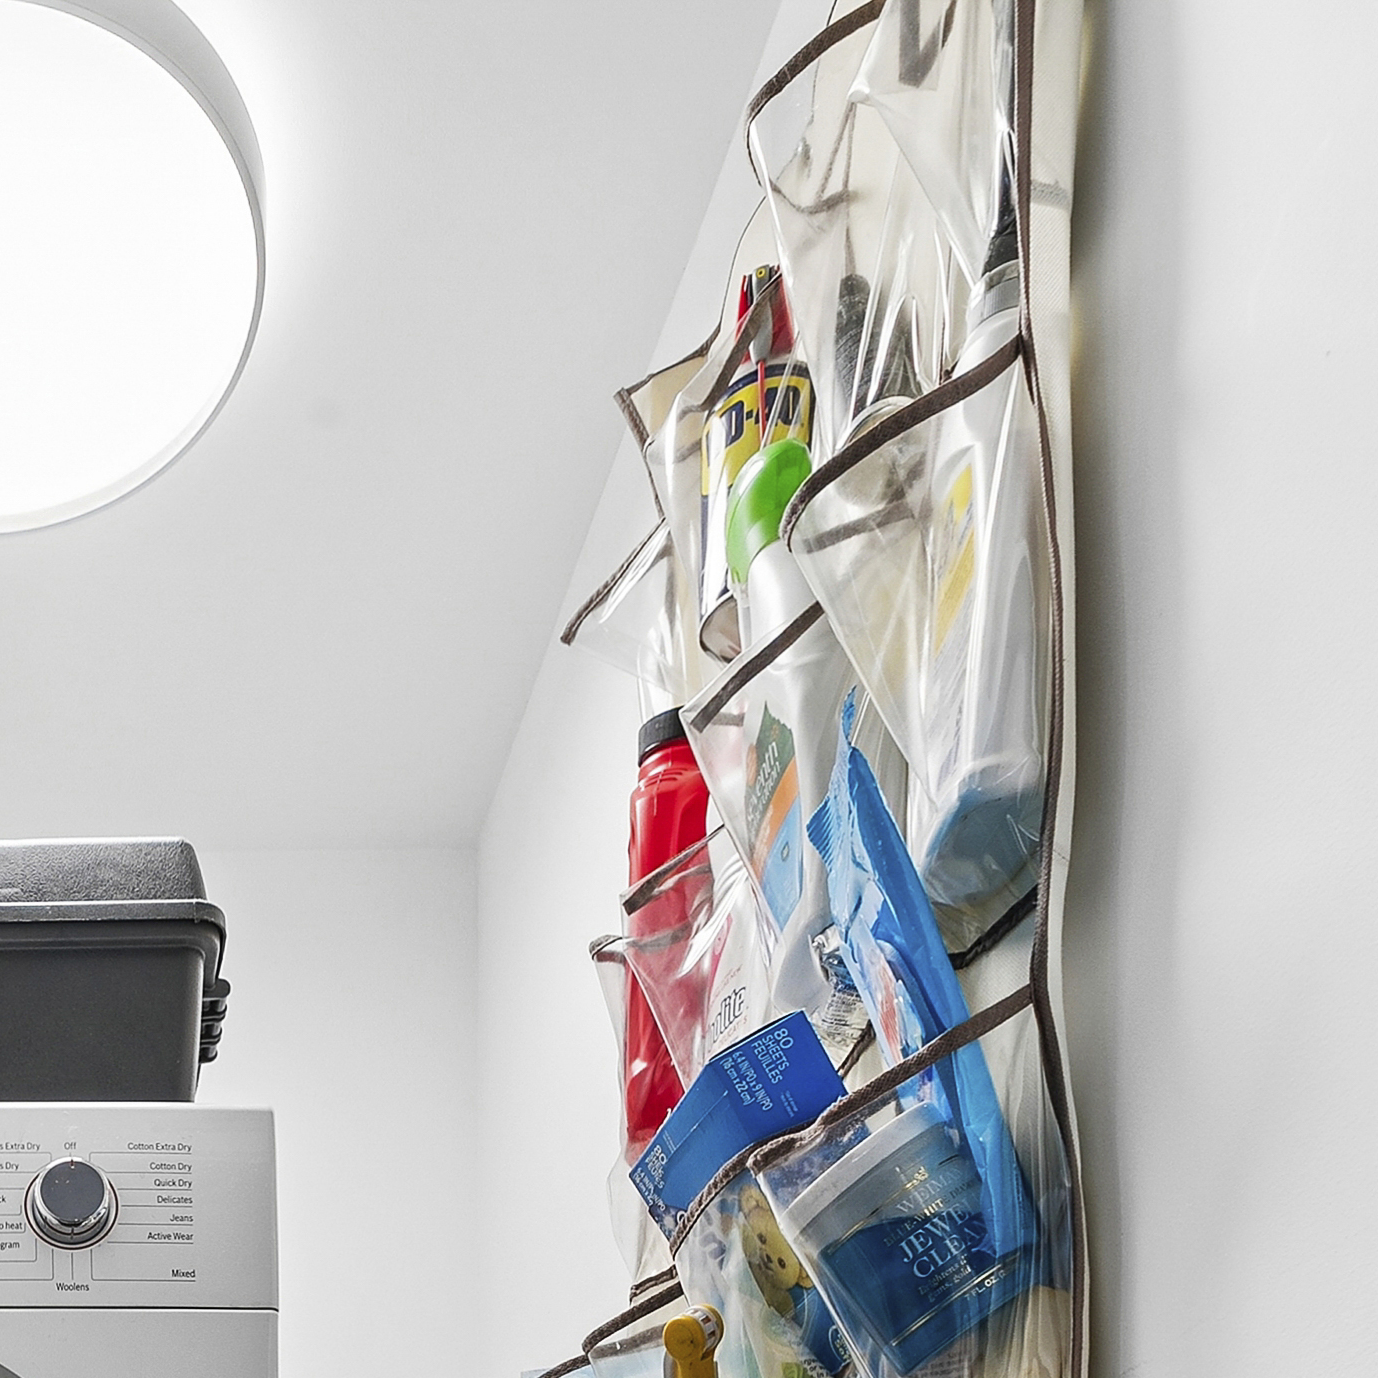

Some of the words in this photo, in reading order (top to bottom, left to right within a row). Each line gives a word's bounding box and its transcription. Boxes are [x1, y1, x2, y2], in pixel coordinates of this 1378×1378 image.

[774, 1028, 794, 1049] 80
[762, 1034, 790, 1070] SHEETS
[751, 1041, 783, 1084] FEUILLES
[735, 1081, 749, 1093] 22
[5, 1142, 25, 1150] Extra
[26, 1142, 41, 1151] Dry
[64, 1142, 77, 1150] Off
[127, 1142, 154, 1151] Cotton
[156, 1143, 176, 1151] Extra
[177, 1143, 192, 1152] Dry
[654, 1144, 667, 1164] 80
[5, 1161, 19, 1171] Dry
[149, 1162, 177, 1170] Cotton
[178, 1162, 192, 1172] Dry
[154, 1178, 177, 1187] Quick
[178, 1179, 192, 1188] Dry
[157, 1195, 193, 1204] Delicates
[170, 1214, 194, 1223] Jeans
[5, 1221, 23, 1230] heat
[147, 1232, 172, 1240] Active
[173, 1232, 194, 1241] Wear
[171, 1269, 196, 1278] Mixed
[56, 1282, 90, 1291] Woolens
